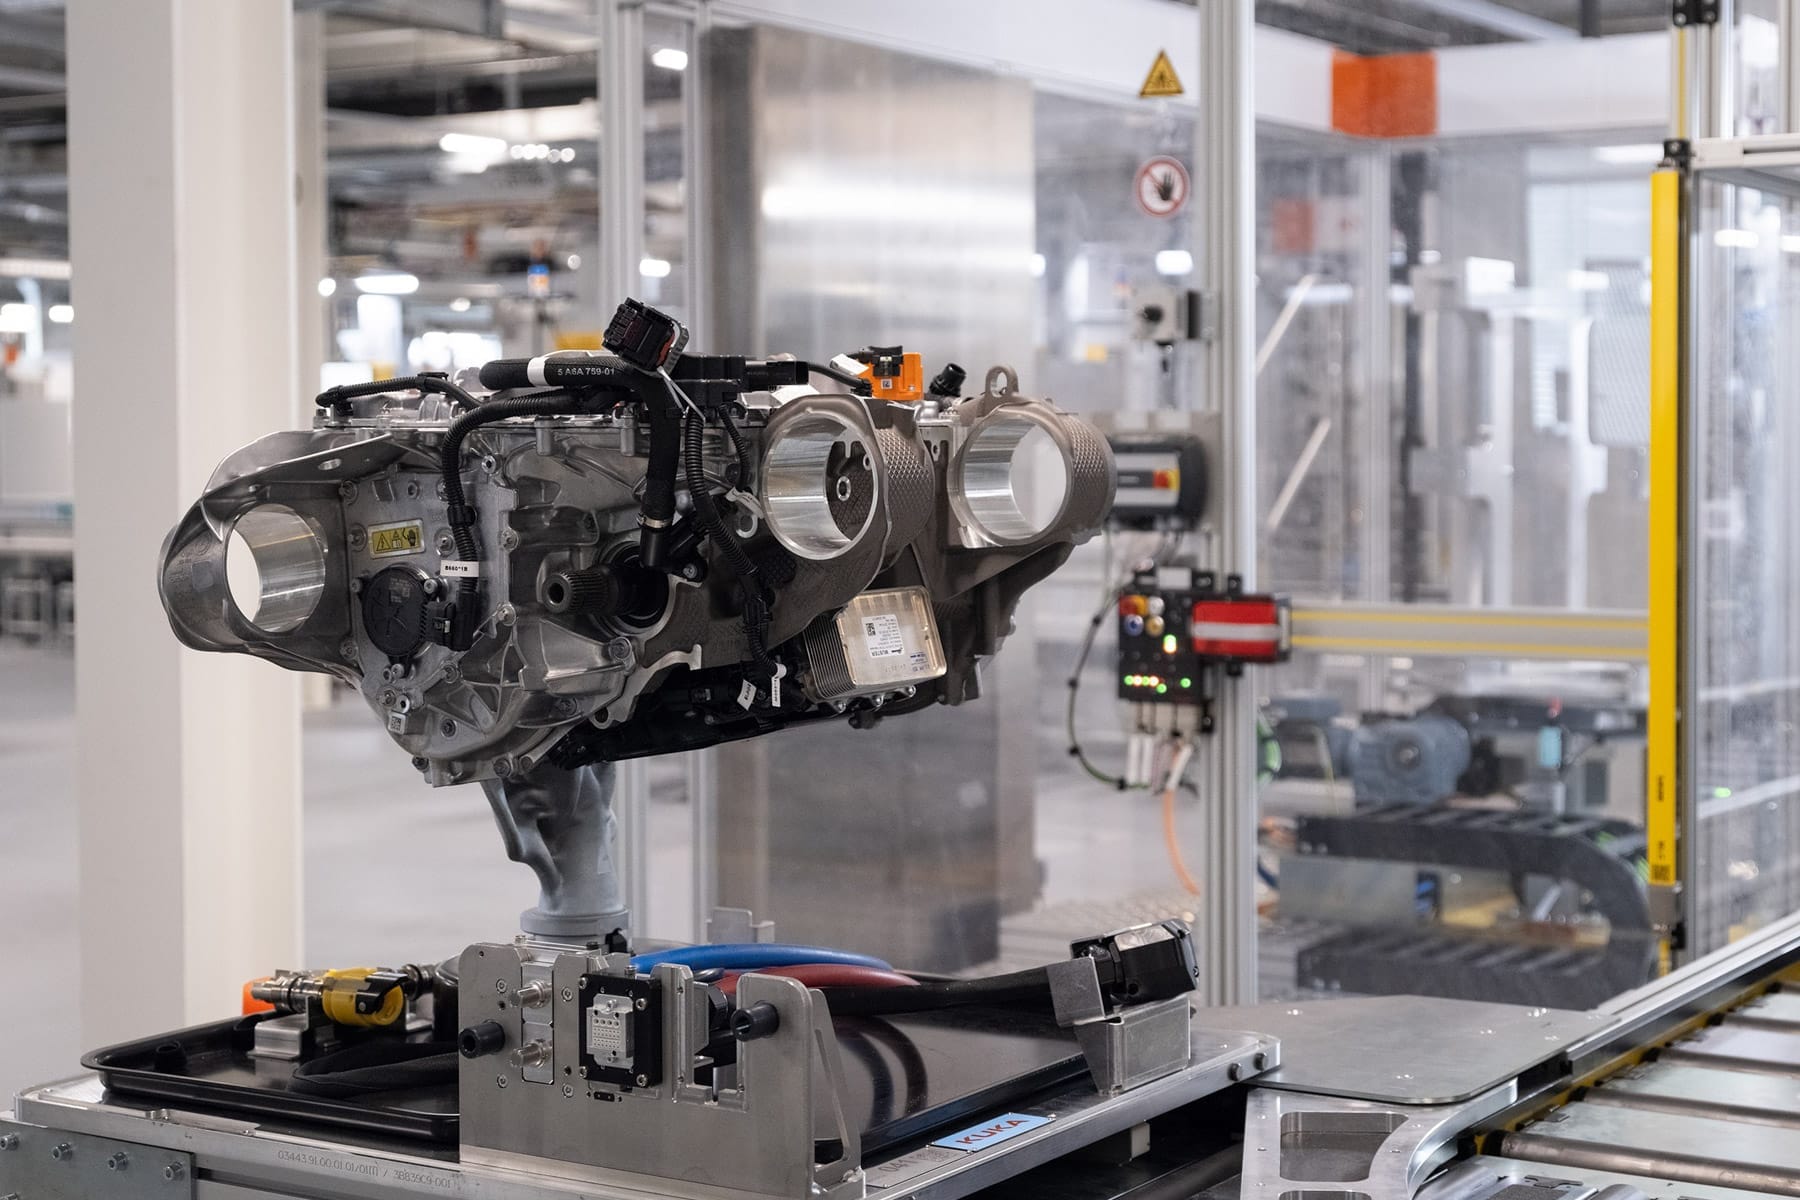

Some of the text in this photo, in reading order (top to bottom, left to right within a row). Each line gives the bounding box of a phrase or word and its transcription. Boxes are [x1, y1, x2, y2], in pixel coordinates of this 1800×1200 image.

[557, 367, 615, 376] 5 A6A 759-01
[955, 1119, 1029, 1145] KUKA
